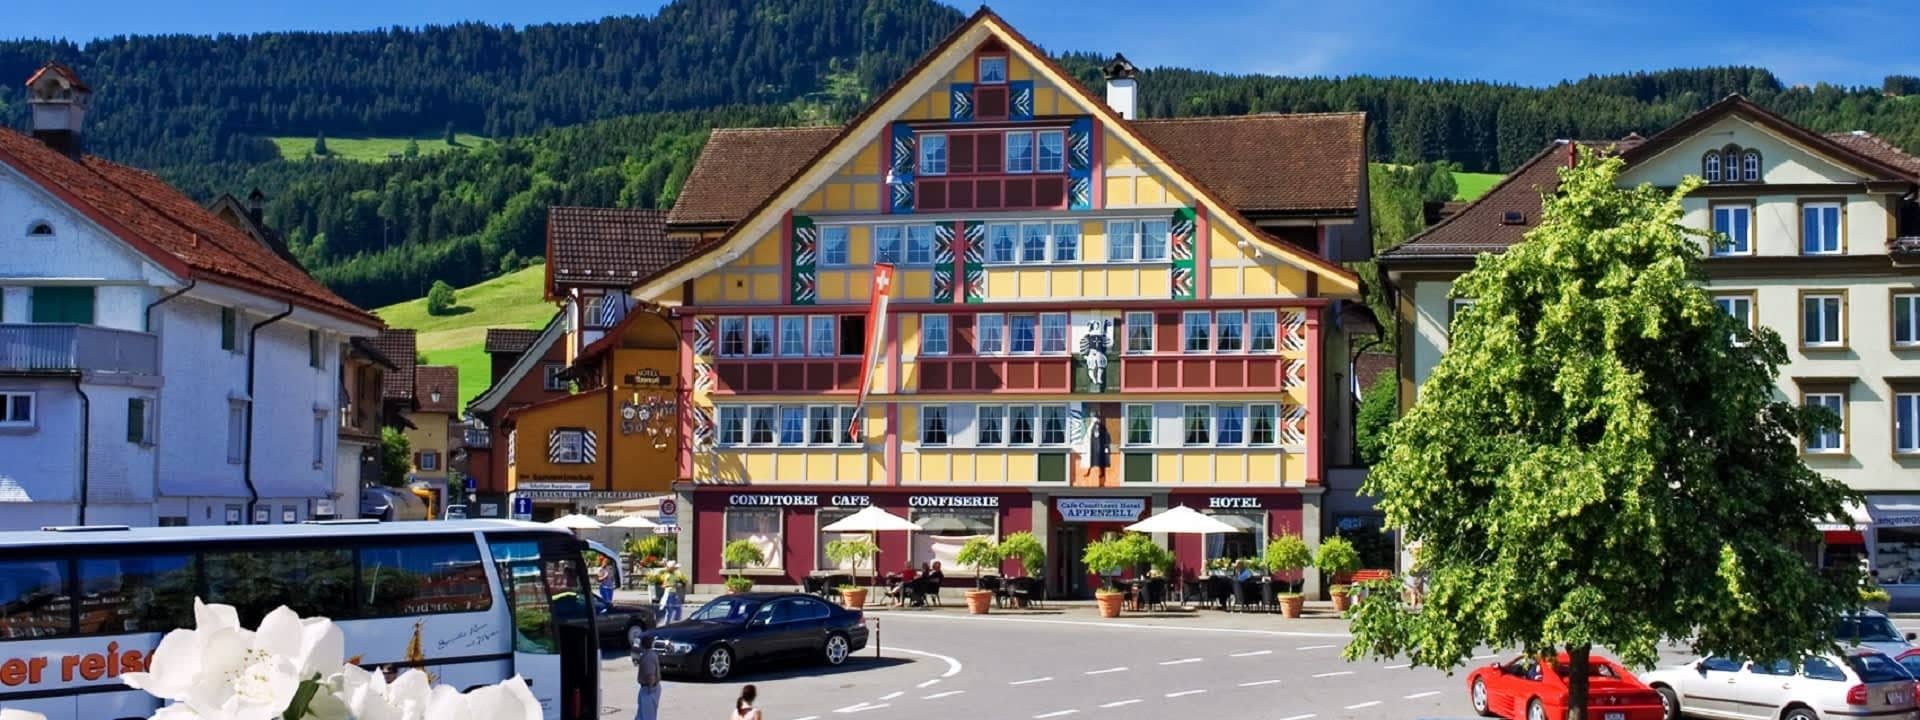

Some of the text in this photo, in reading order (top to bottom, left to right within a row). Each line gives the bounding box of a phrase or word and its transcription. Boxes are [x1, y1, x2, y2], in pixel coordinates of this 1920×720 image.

[729, 495, 999, 506] CONDITOREI CAFE CONFISERIE
[1209, 497, 1262, 508] HOTEL
[1067, 509, 1134, 517] APPENZELL
[0, 641, 154, 686] er reis
